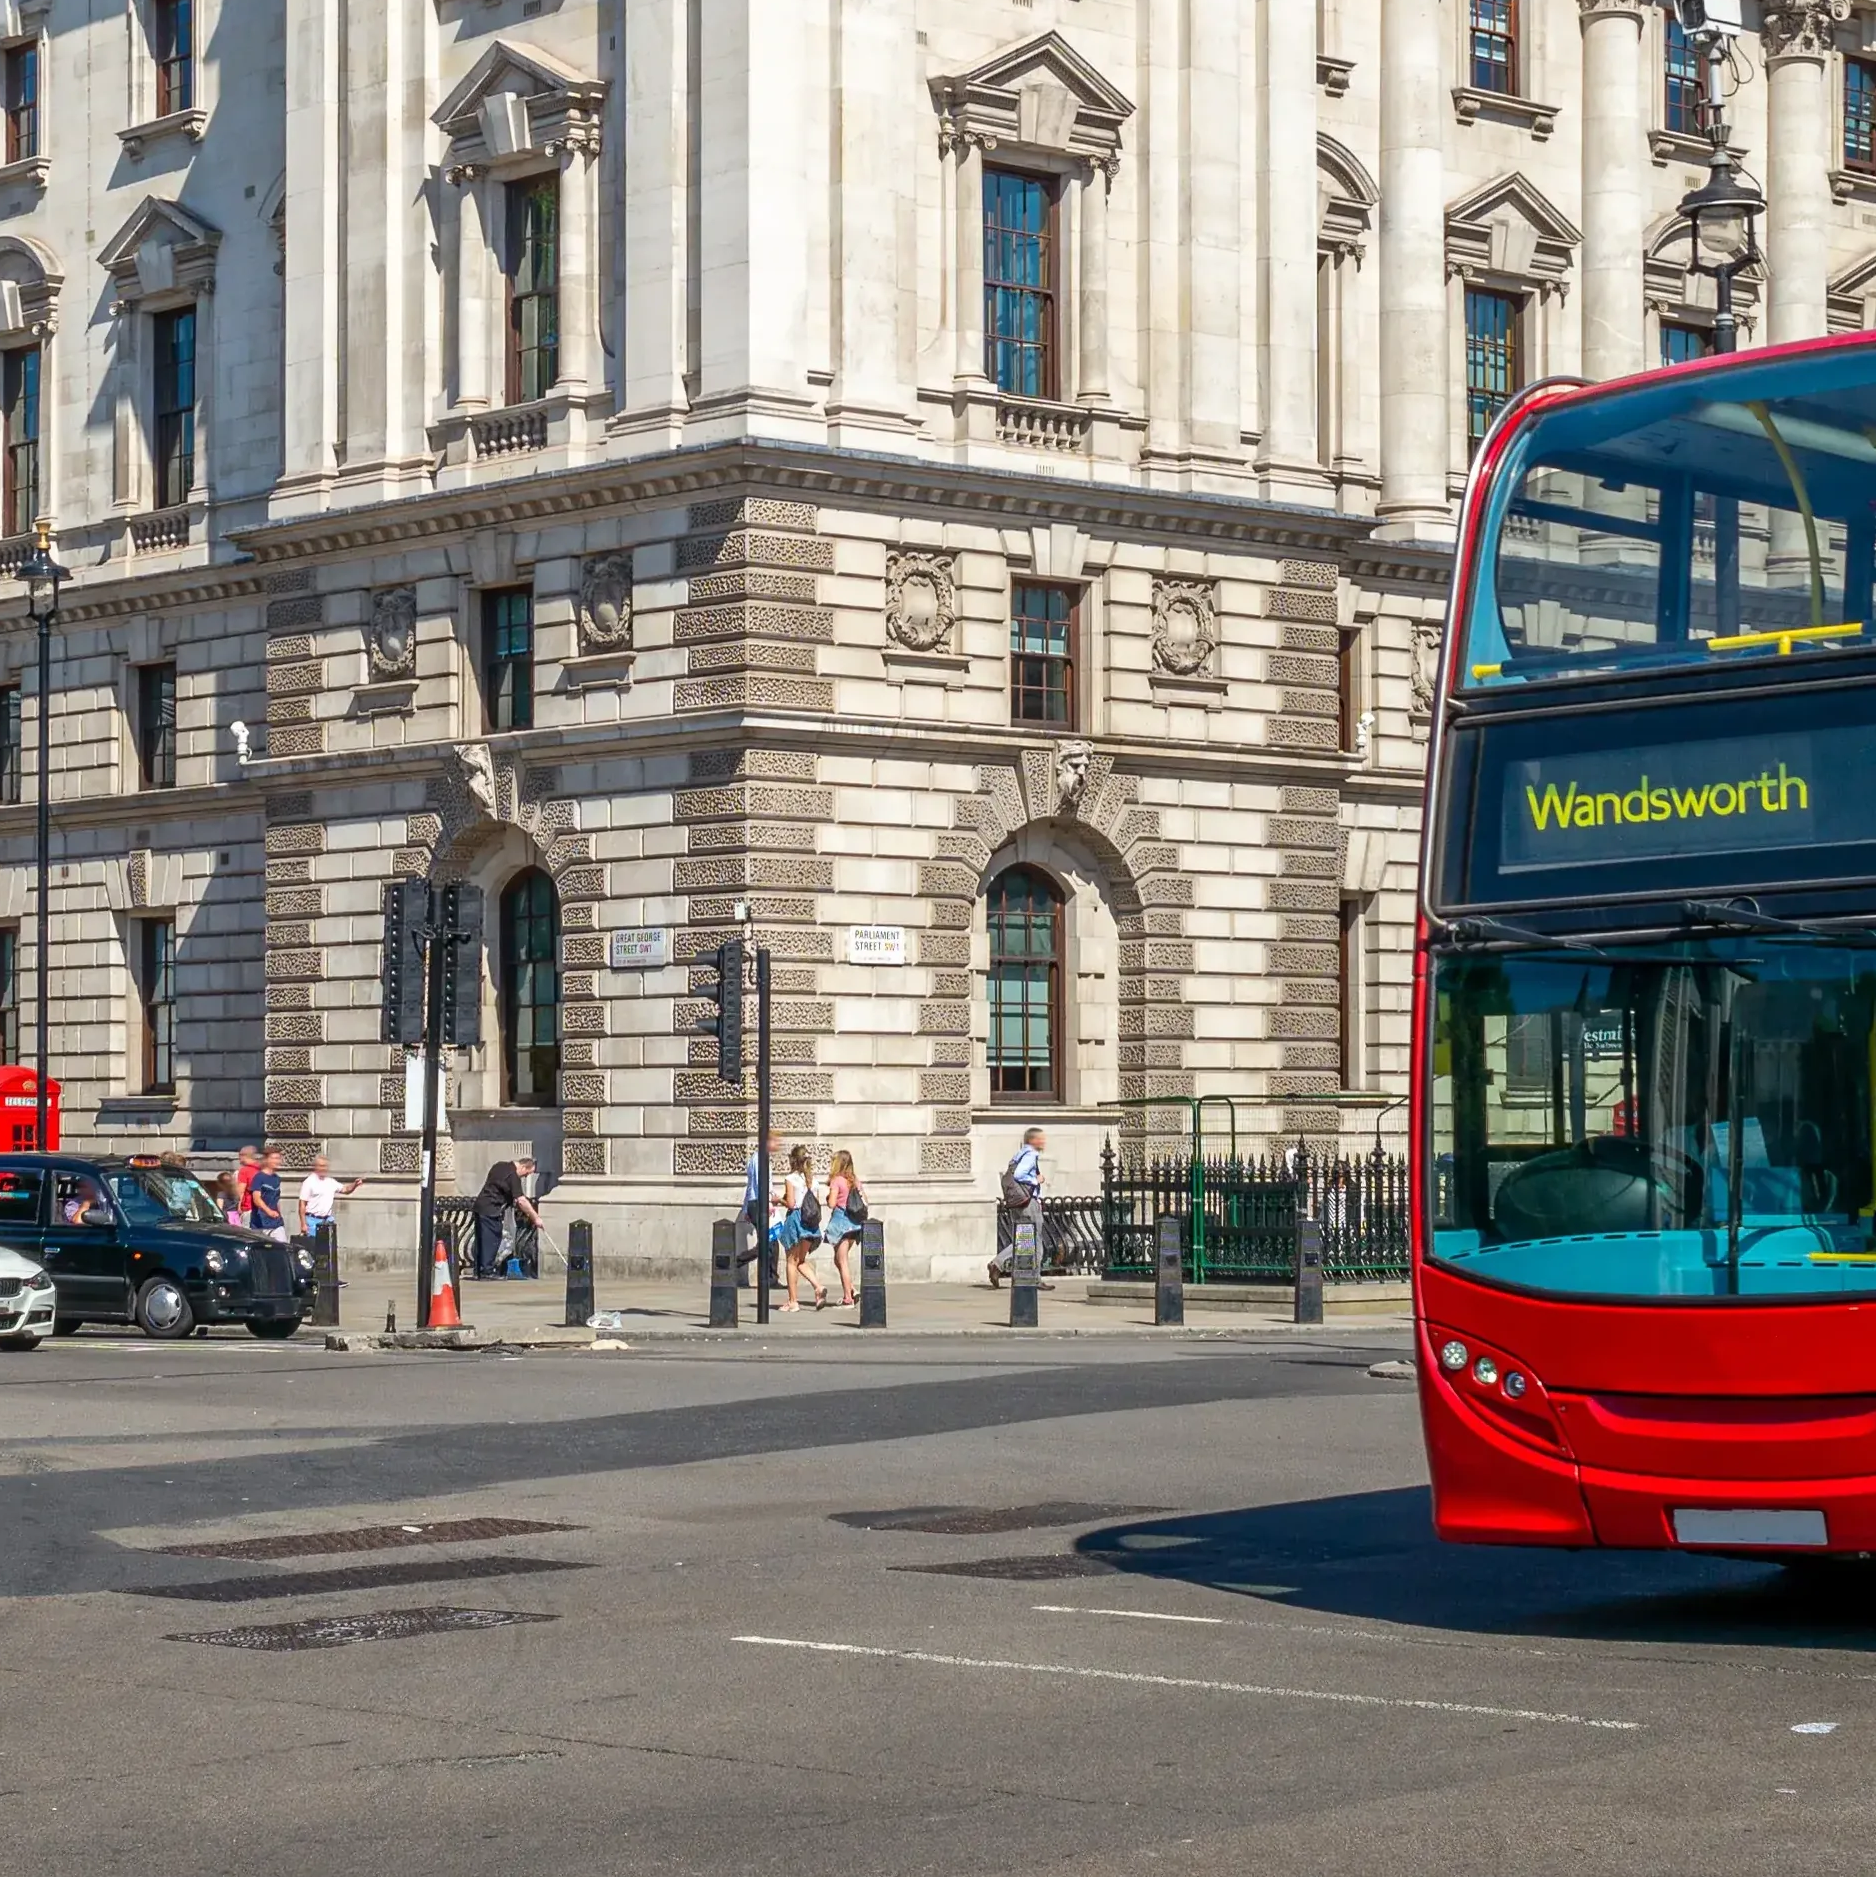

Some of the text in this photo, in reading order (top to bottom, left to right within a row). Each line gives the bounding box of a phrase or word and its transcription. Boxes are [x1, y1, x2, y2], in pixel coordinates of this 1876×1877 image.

[1526, 763, 1808, 830] Wandsworth
[615, 931, 661, 943] GREAT GEORGE
[854, 929, 899, 940] PARLIAMENT
[615, 943, 652, 954] STREET SW1
[854, 941, 899, 951] STREET SW1
